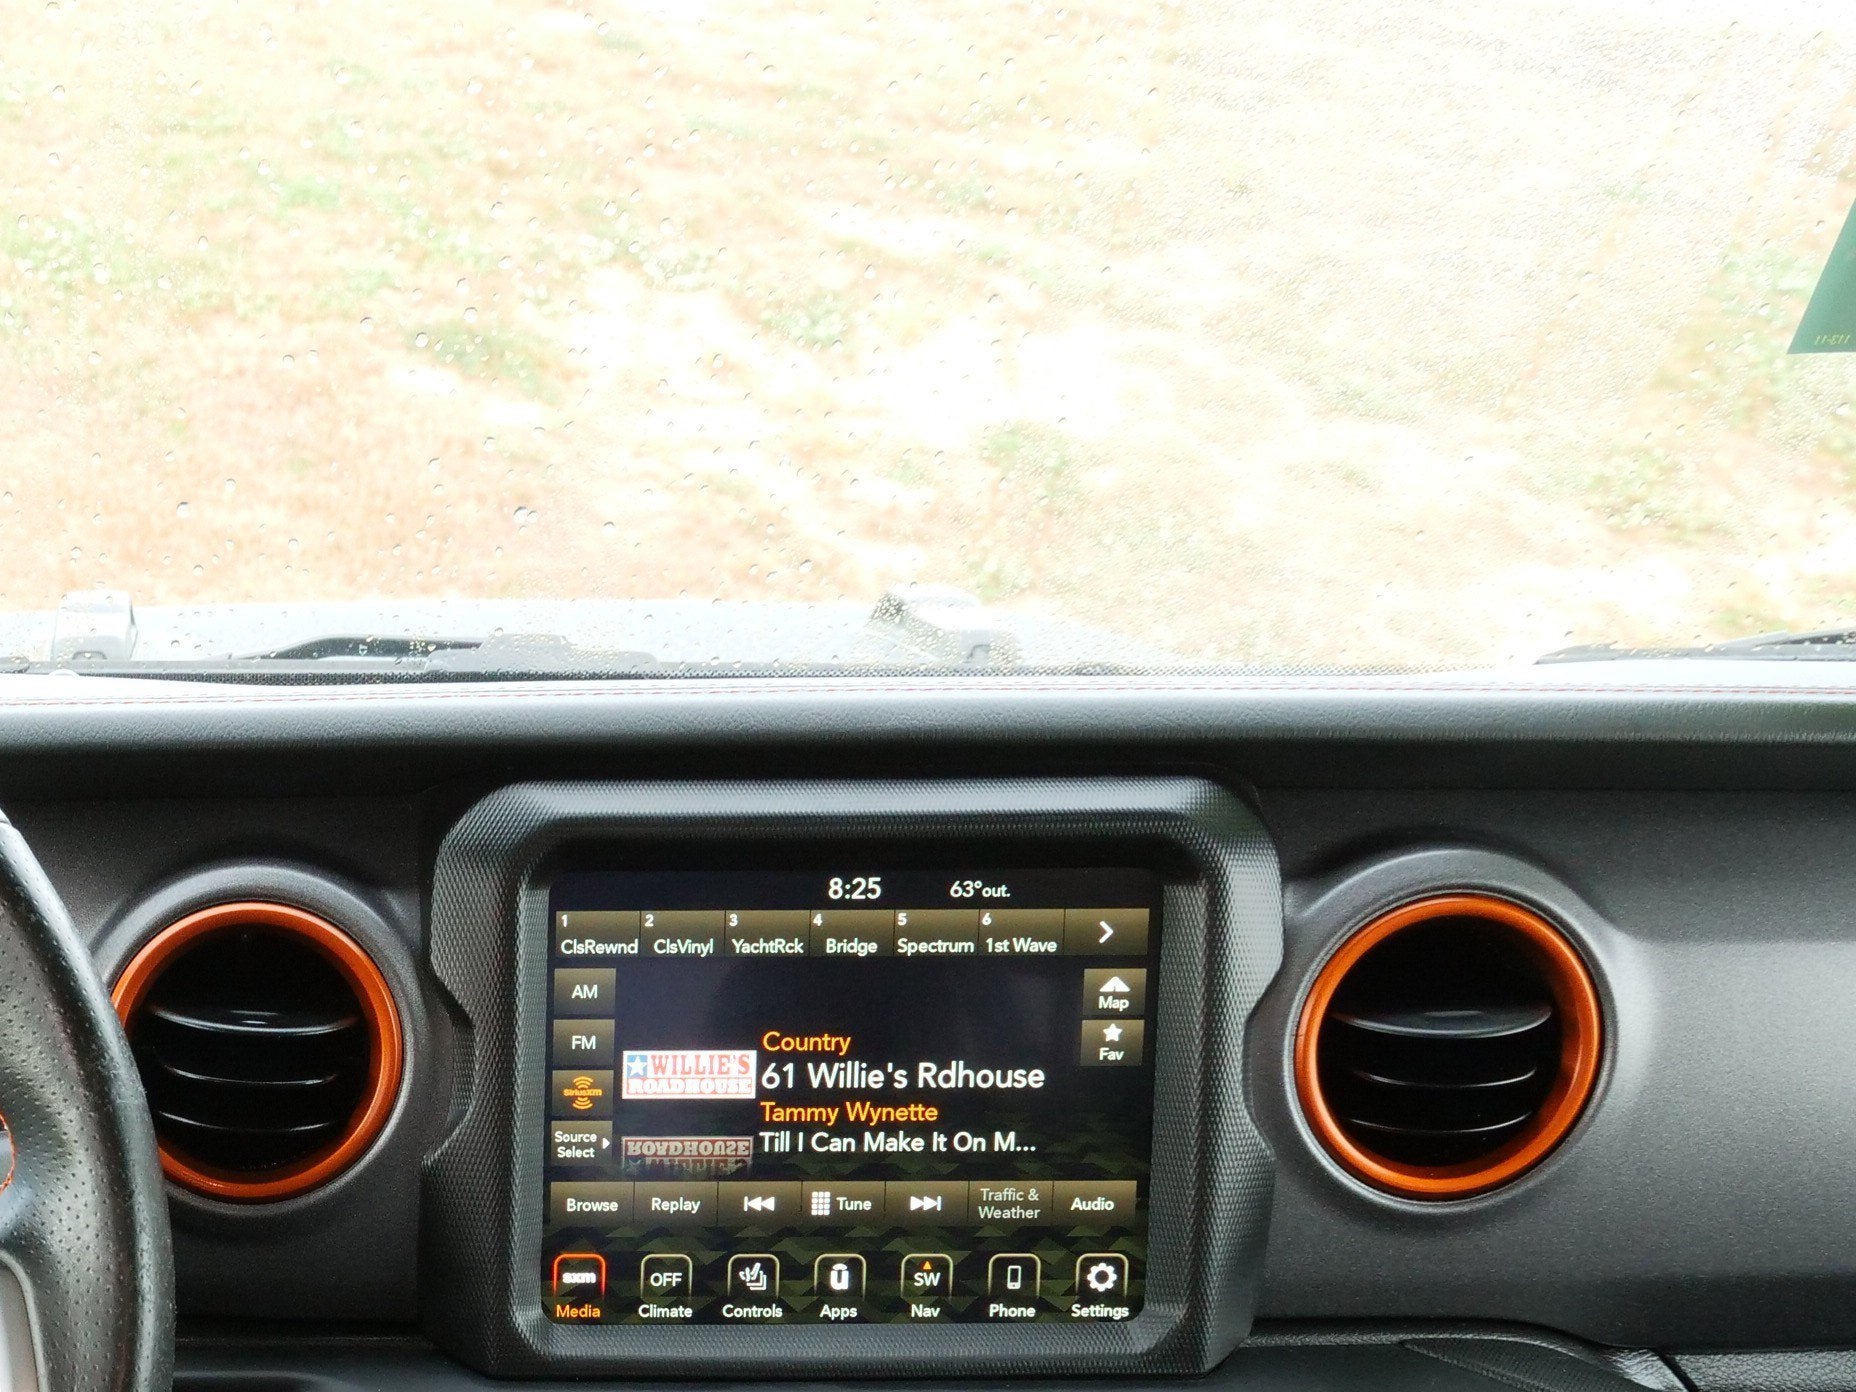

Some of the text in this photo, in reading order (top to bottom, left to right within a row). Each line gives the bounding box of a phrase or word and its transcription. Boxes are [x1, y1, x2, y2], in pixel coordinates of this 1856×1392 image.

[828, 878, 882, 900] 8:25
[561, 914, 569, 927] 1
[645, 914, 654, 927] 2
[729, 914, 738, 927] 3
[813, 913, 823, 927] 4
[897, 913, 907, 926] 5
[982, 913, 992, 926] 6
[560, 938, 639, 955] ClsRewnd
[653, 937, 714, 956] ClsVinyl
[731, 937, 804, 954] YachtRck
[826, 937, 878, 956] Bridge
[897, 937, 975, 956] Spectrum
[985, 937, 1057, 953] 1st Wave
[571, 985, 598, 999] AM
[1098, 996, 1129, 1012] Map
[571, 1036, 596, 1050] FM
[763, 1030, 852, 1056] Country
[1099, 1047, 1124, 1061] Fav
[650, 1054, 750, 1075] WILLIE'S
[761, 1061, 1046, 1089] 61 Willie's Rdhouse
[627, 1077, 752, 1095] ROADHOUSE
[760, 1101, 939, 1126] Tammy Wynette
[554, 1131, 598, 1143] Source
[759, 1132, 792, 1153] Till
[811, 1132, 858, 1153] Can
[863, 1131, 927, 1152] Make
[933, 1132, 947, 1152] It
[953, 1132, 986, 1152] On
[557, 1146, 596, 1158] Select
[980, 1188, 1040, 1203] Traffic &
[566, 1198, 619, 1213] Browse
[651, 1198, 701, 1214] Replay
[836, 1198, 872, 1211] Tune
[1071, 1197, 1115, 1211] Audio
[978, 1205, 1041, 1220] Weather
[650, 1272, 682, 1287] OFF
[913, 1272, 941, 1287] SW
[556, 1304, 601, 1319] Media
[638, 1303, 693, 1319] Climate
[722, 1303, 783, 1319] Controls
[820, 1304, 858, 1322] Apps
[910, 1305, 940, 1318] Nav
[989, 1303, 1036, 1319] Phone
[1071, 1303, 1130, 1322] Settings
